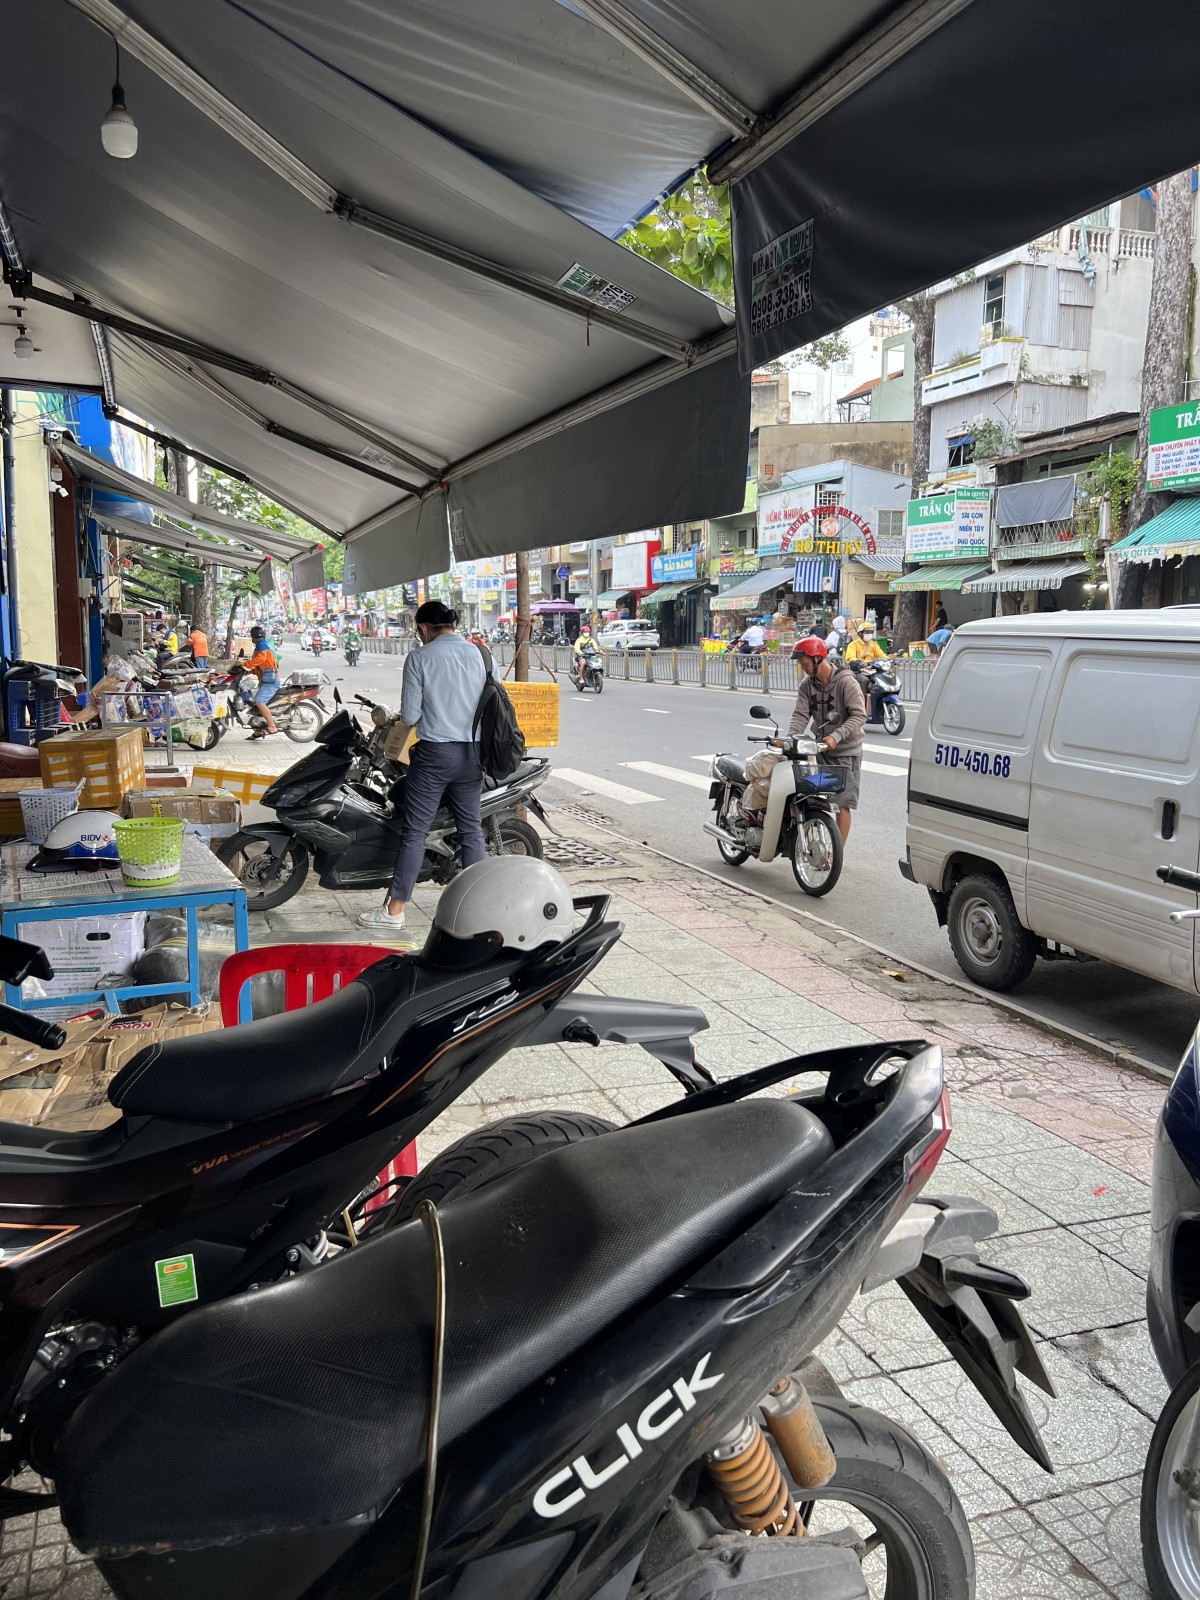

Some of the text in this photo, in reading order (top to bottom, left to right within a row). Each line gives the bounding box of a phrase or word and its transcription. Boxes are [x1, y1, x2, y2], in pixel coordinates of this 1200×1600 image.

[838, 506, 853, 519] HOA
[919, 499, 942, 517] TRẦN
[793, 534, 814, 554] HỒ
[816, 541, 841, 558] THỊ
[935, 744, 1011, 778] 51D-450.68
[533, 1351, 725, 1518] CLICK
